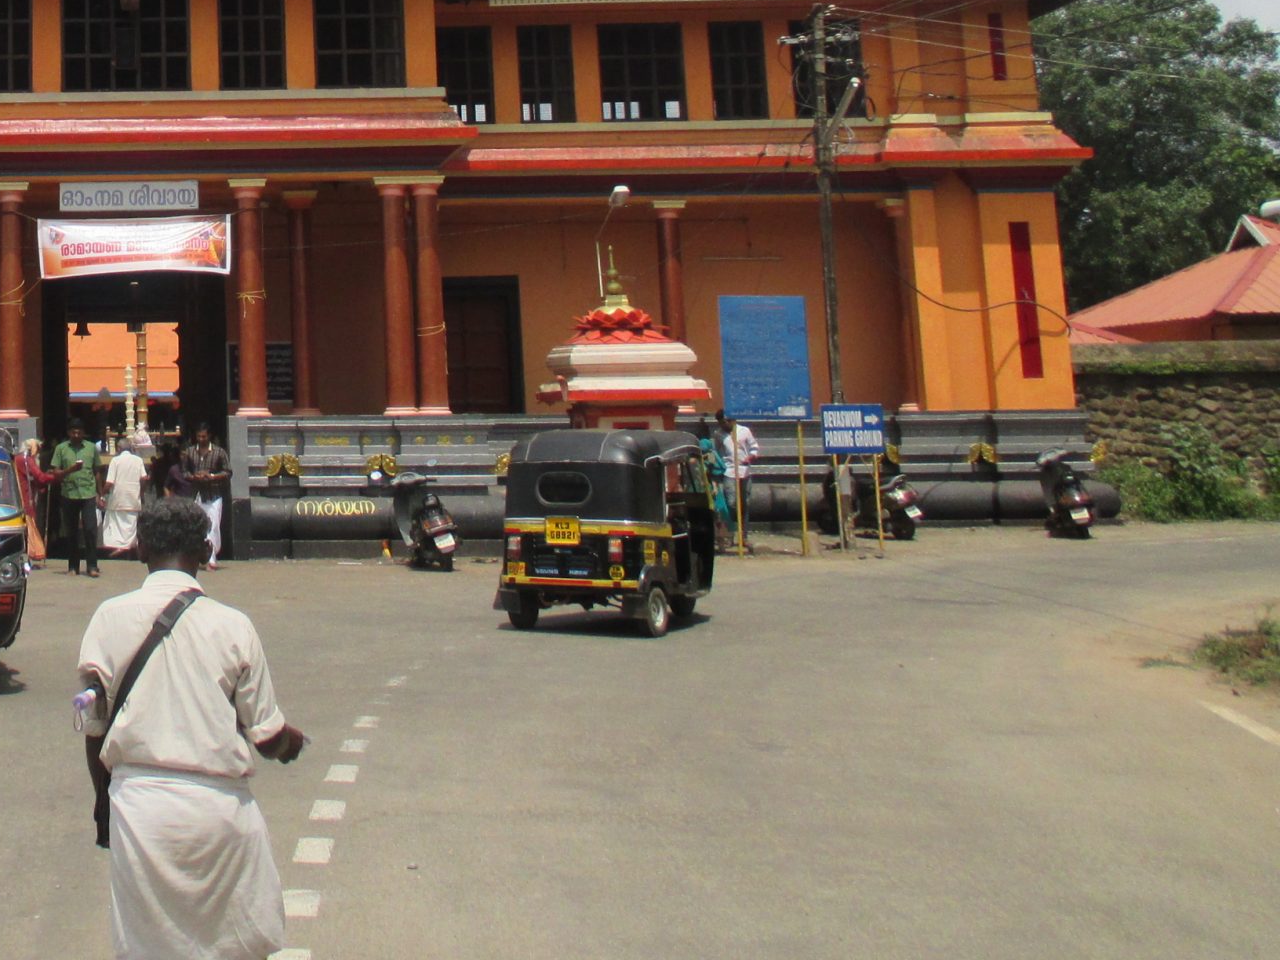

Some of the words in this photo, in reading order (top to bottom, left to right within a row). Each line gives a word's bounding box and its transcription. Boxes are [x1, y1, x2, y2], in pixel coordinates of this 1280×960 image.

[128, 184, 197, 206] ശിവായ
[823, 410, 863, 428] DEVASWOM
[824, 430, 854, 447] PARKING
[855, 429, 883, 447] GROUND
